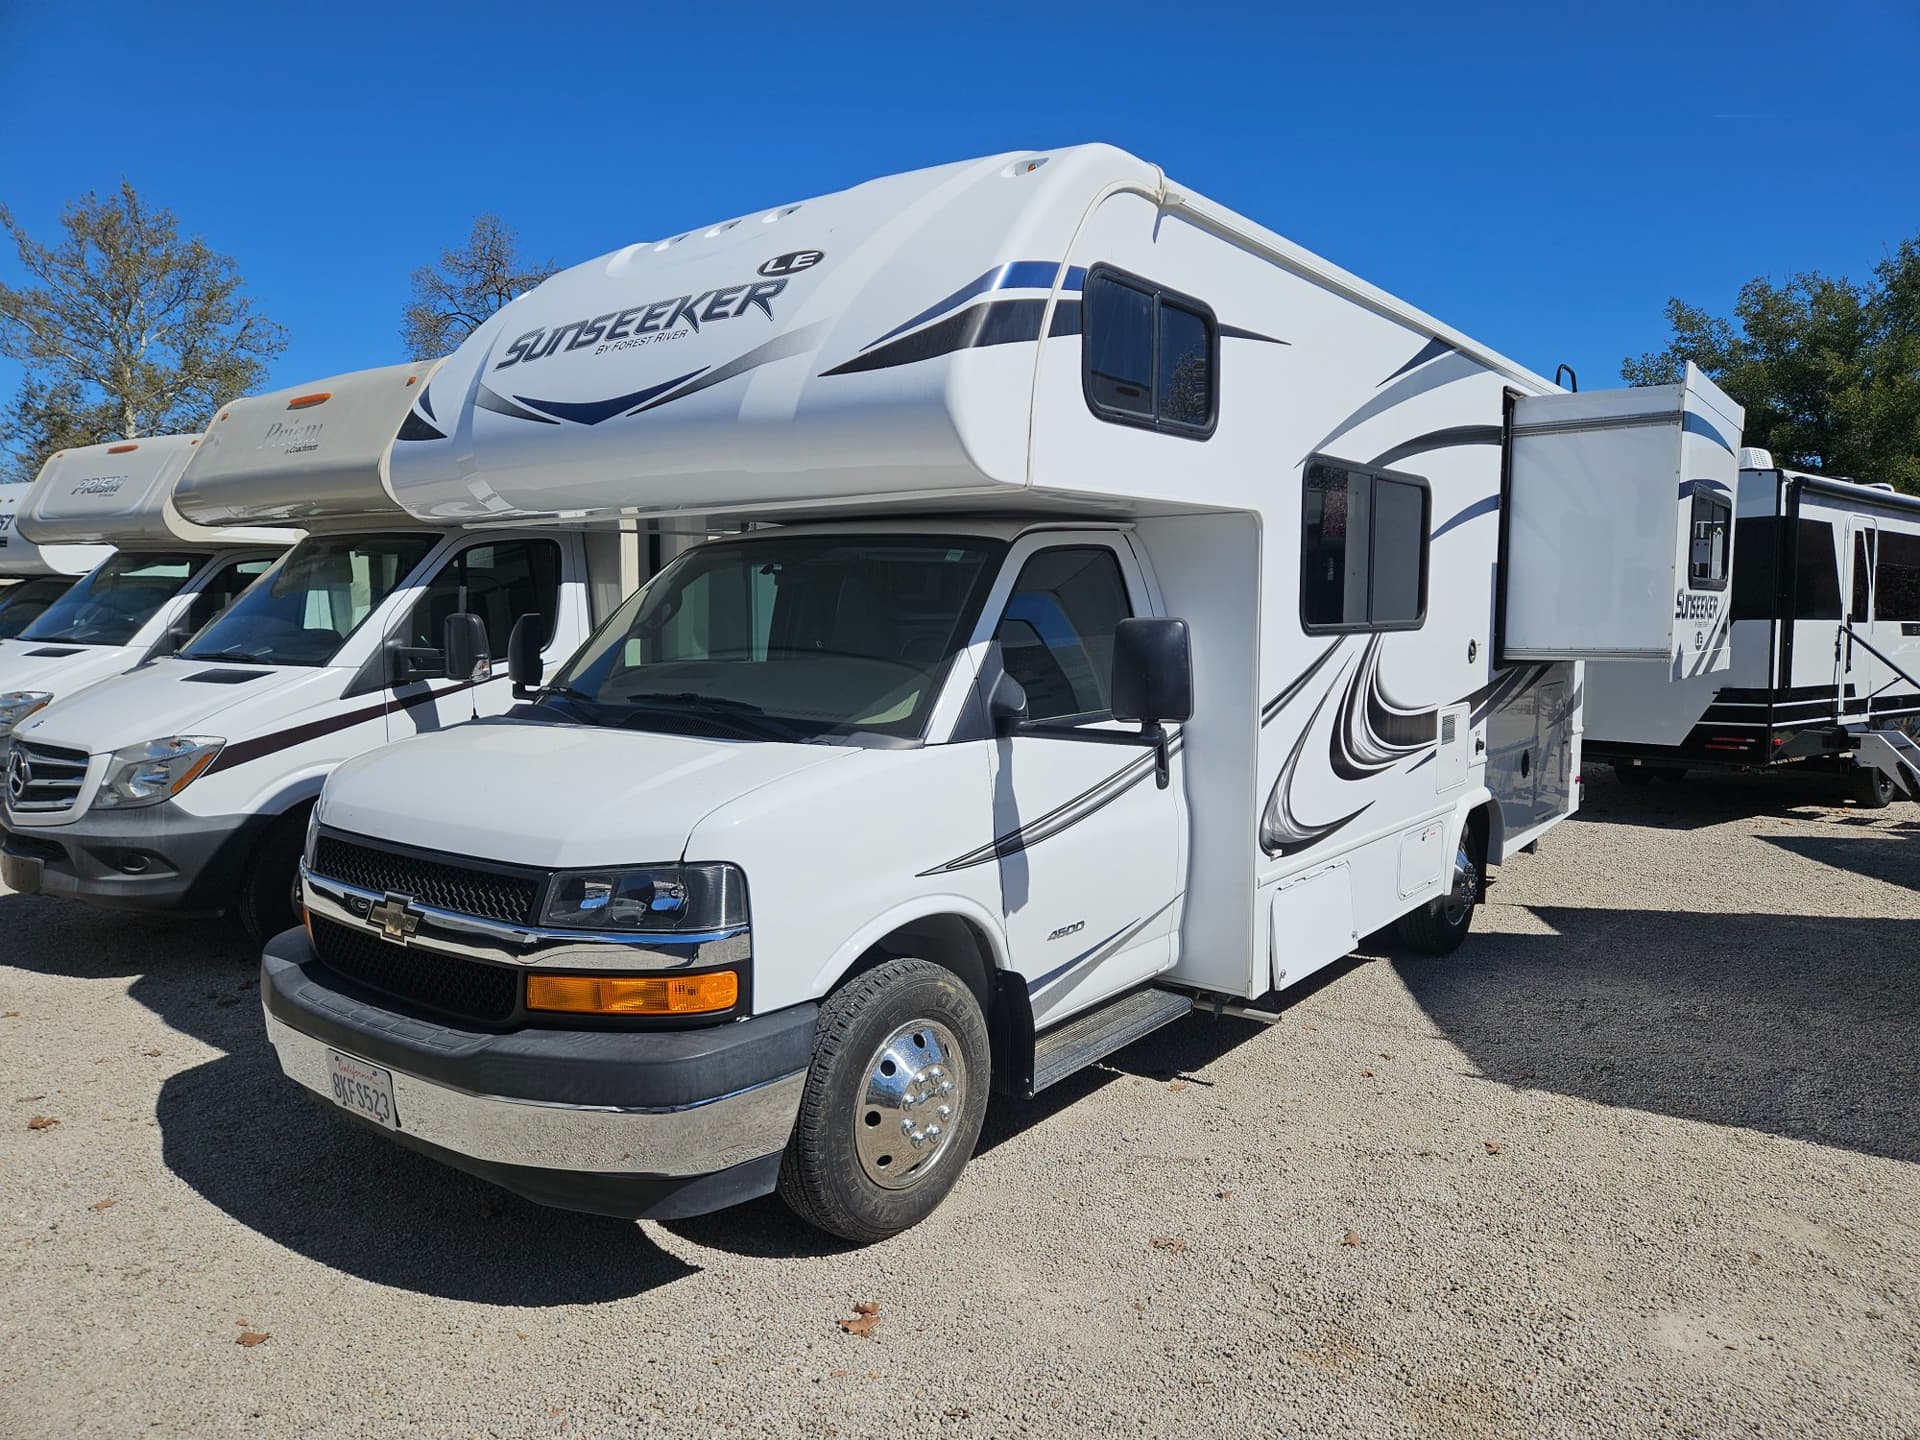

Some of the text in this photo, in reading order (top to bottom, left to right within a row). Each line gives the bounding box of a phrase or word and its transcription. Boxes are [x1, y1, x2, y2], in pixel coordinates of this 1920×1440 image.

[762, 251, 820, 273] LE
[494, 279, 788, 370] SUNSEEKER
[595, 328, 689, 355] BY FOREST RIVER
[1046, 919, 1085, 942] 4500
[332, 1072, 390, 1119] 8KFS523
